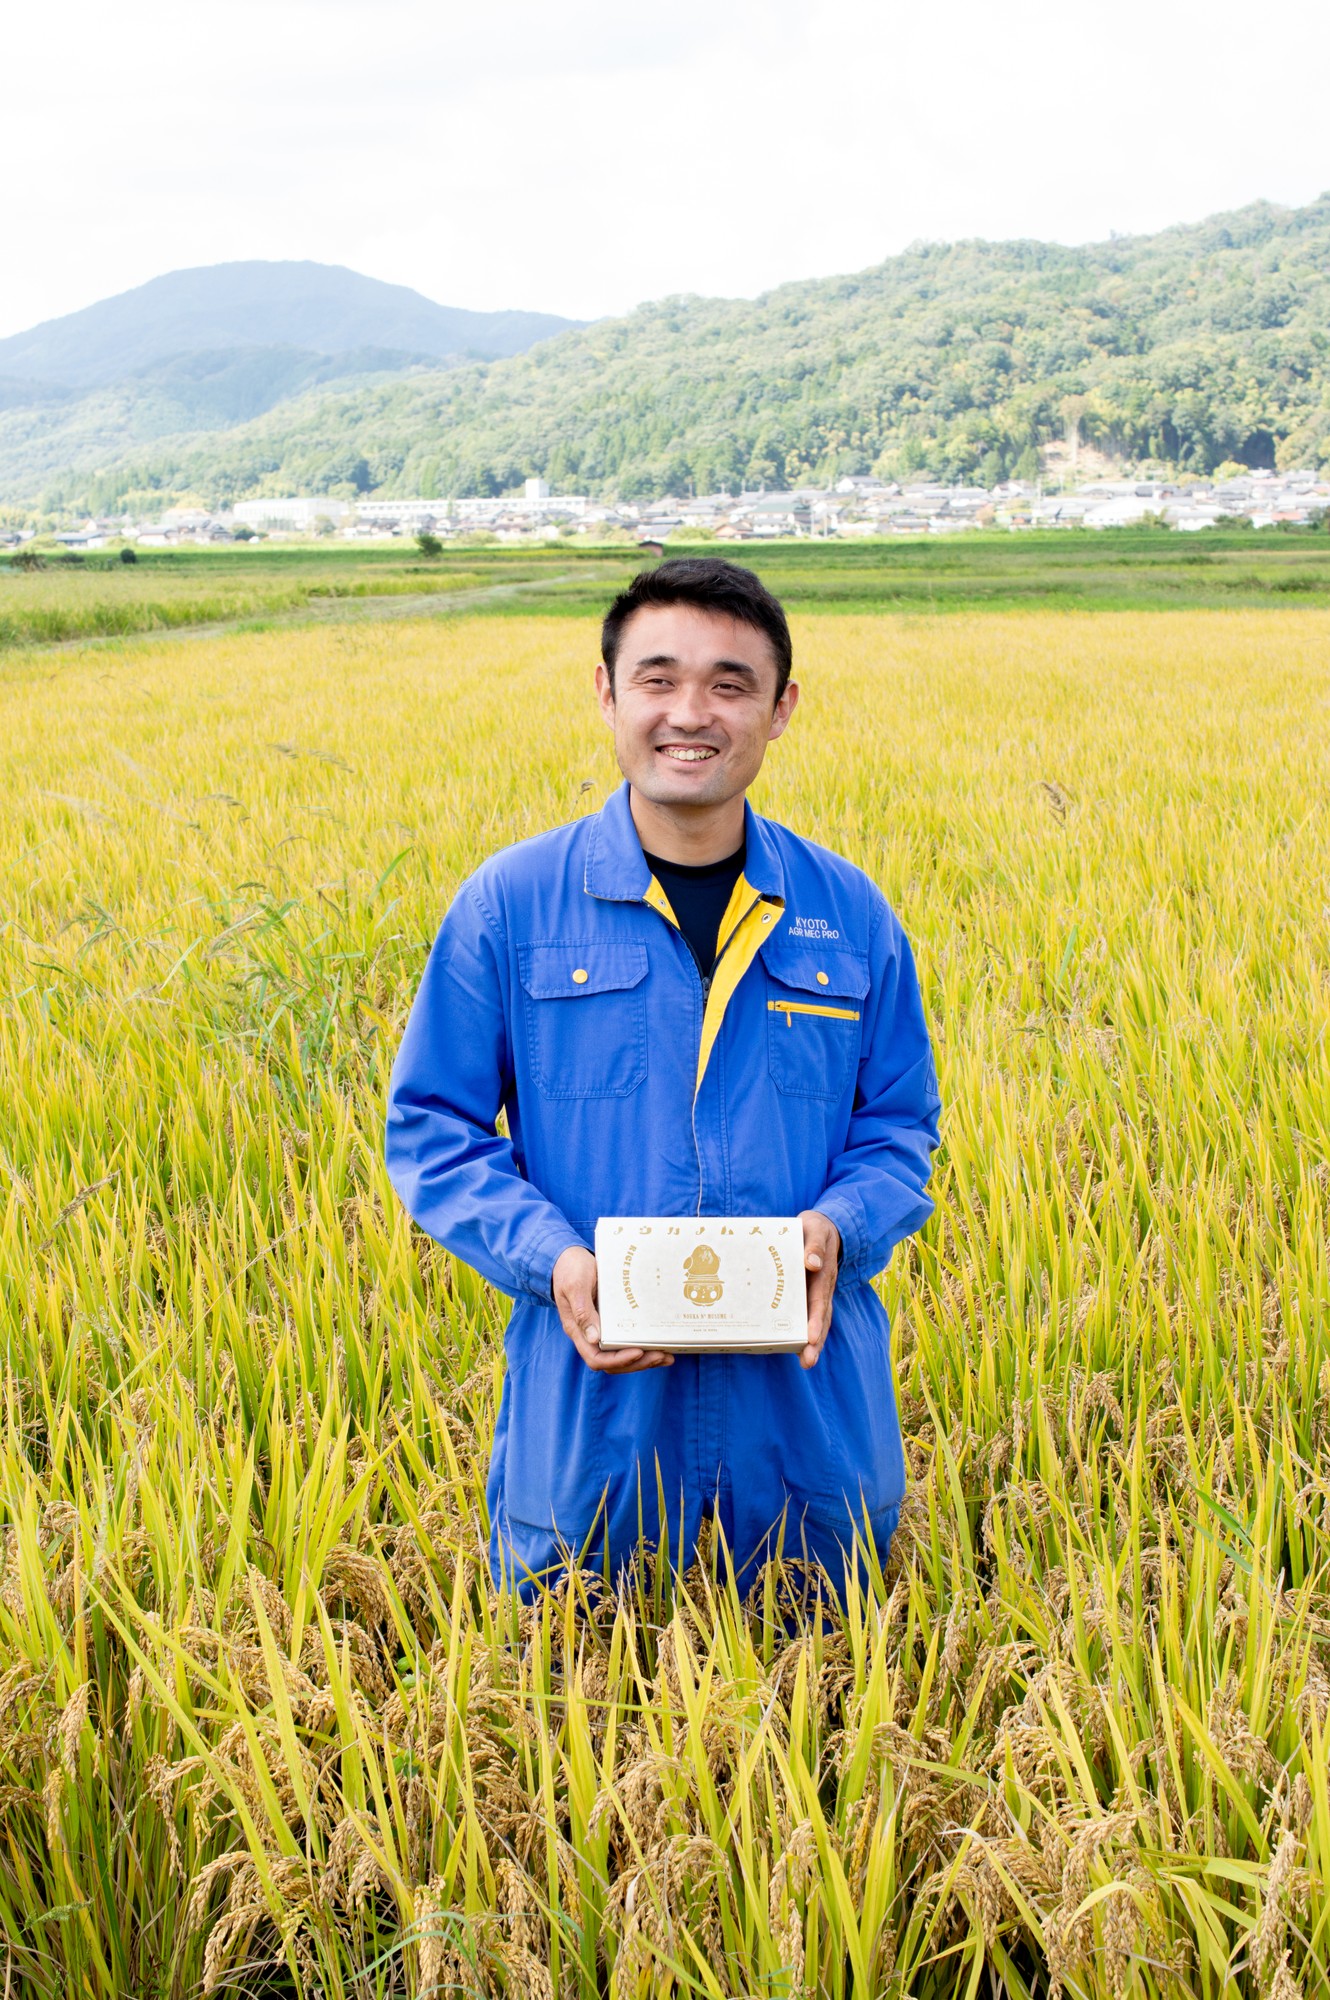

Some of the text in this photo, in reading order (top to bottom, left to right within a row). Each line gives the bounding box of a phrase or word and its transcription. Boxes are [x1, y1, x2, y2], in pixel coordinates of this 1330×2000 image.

[795, 916, 828, 930] KYOTO
[804, 928, 821, 939] MEC
[822, 929, 840, 939] PRO
[623, 1244, 637, 1267] RICE
[622, 1269, 639, 1310] BISCUIT
